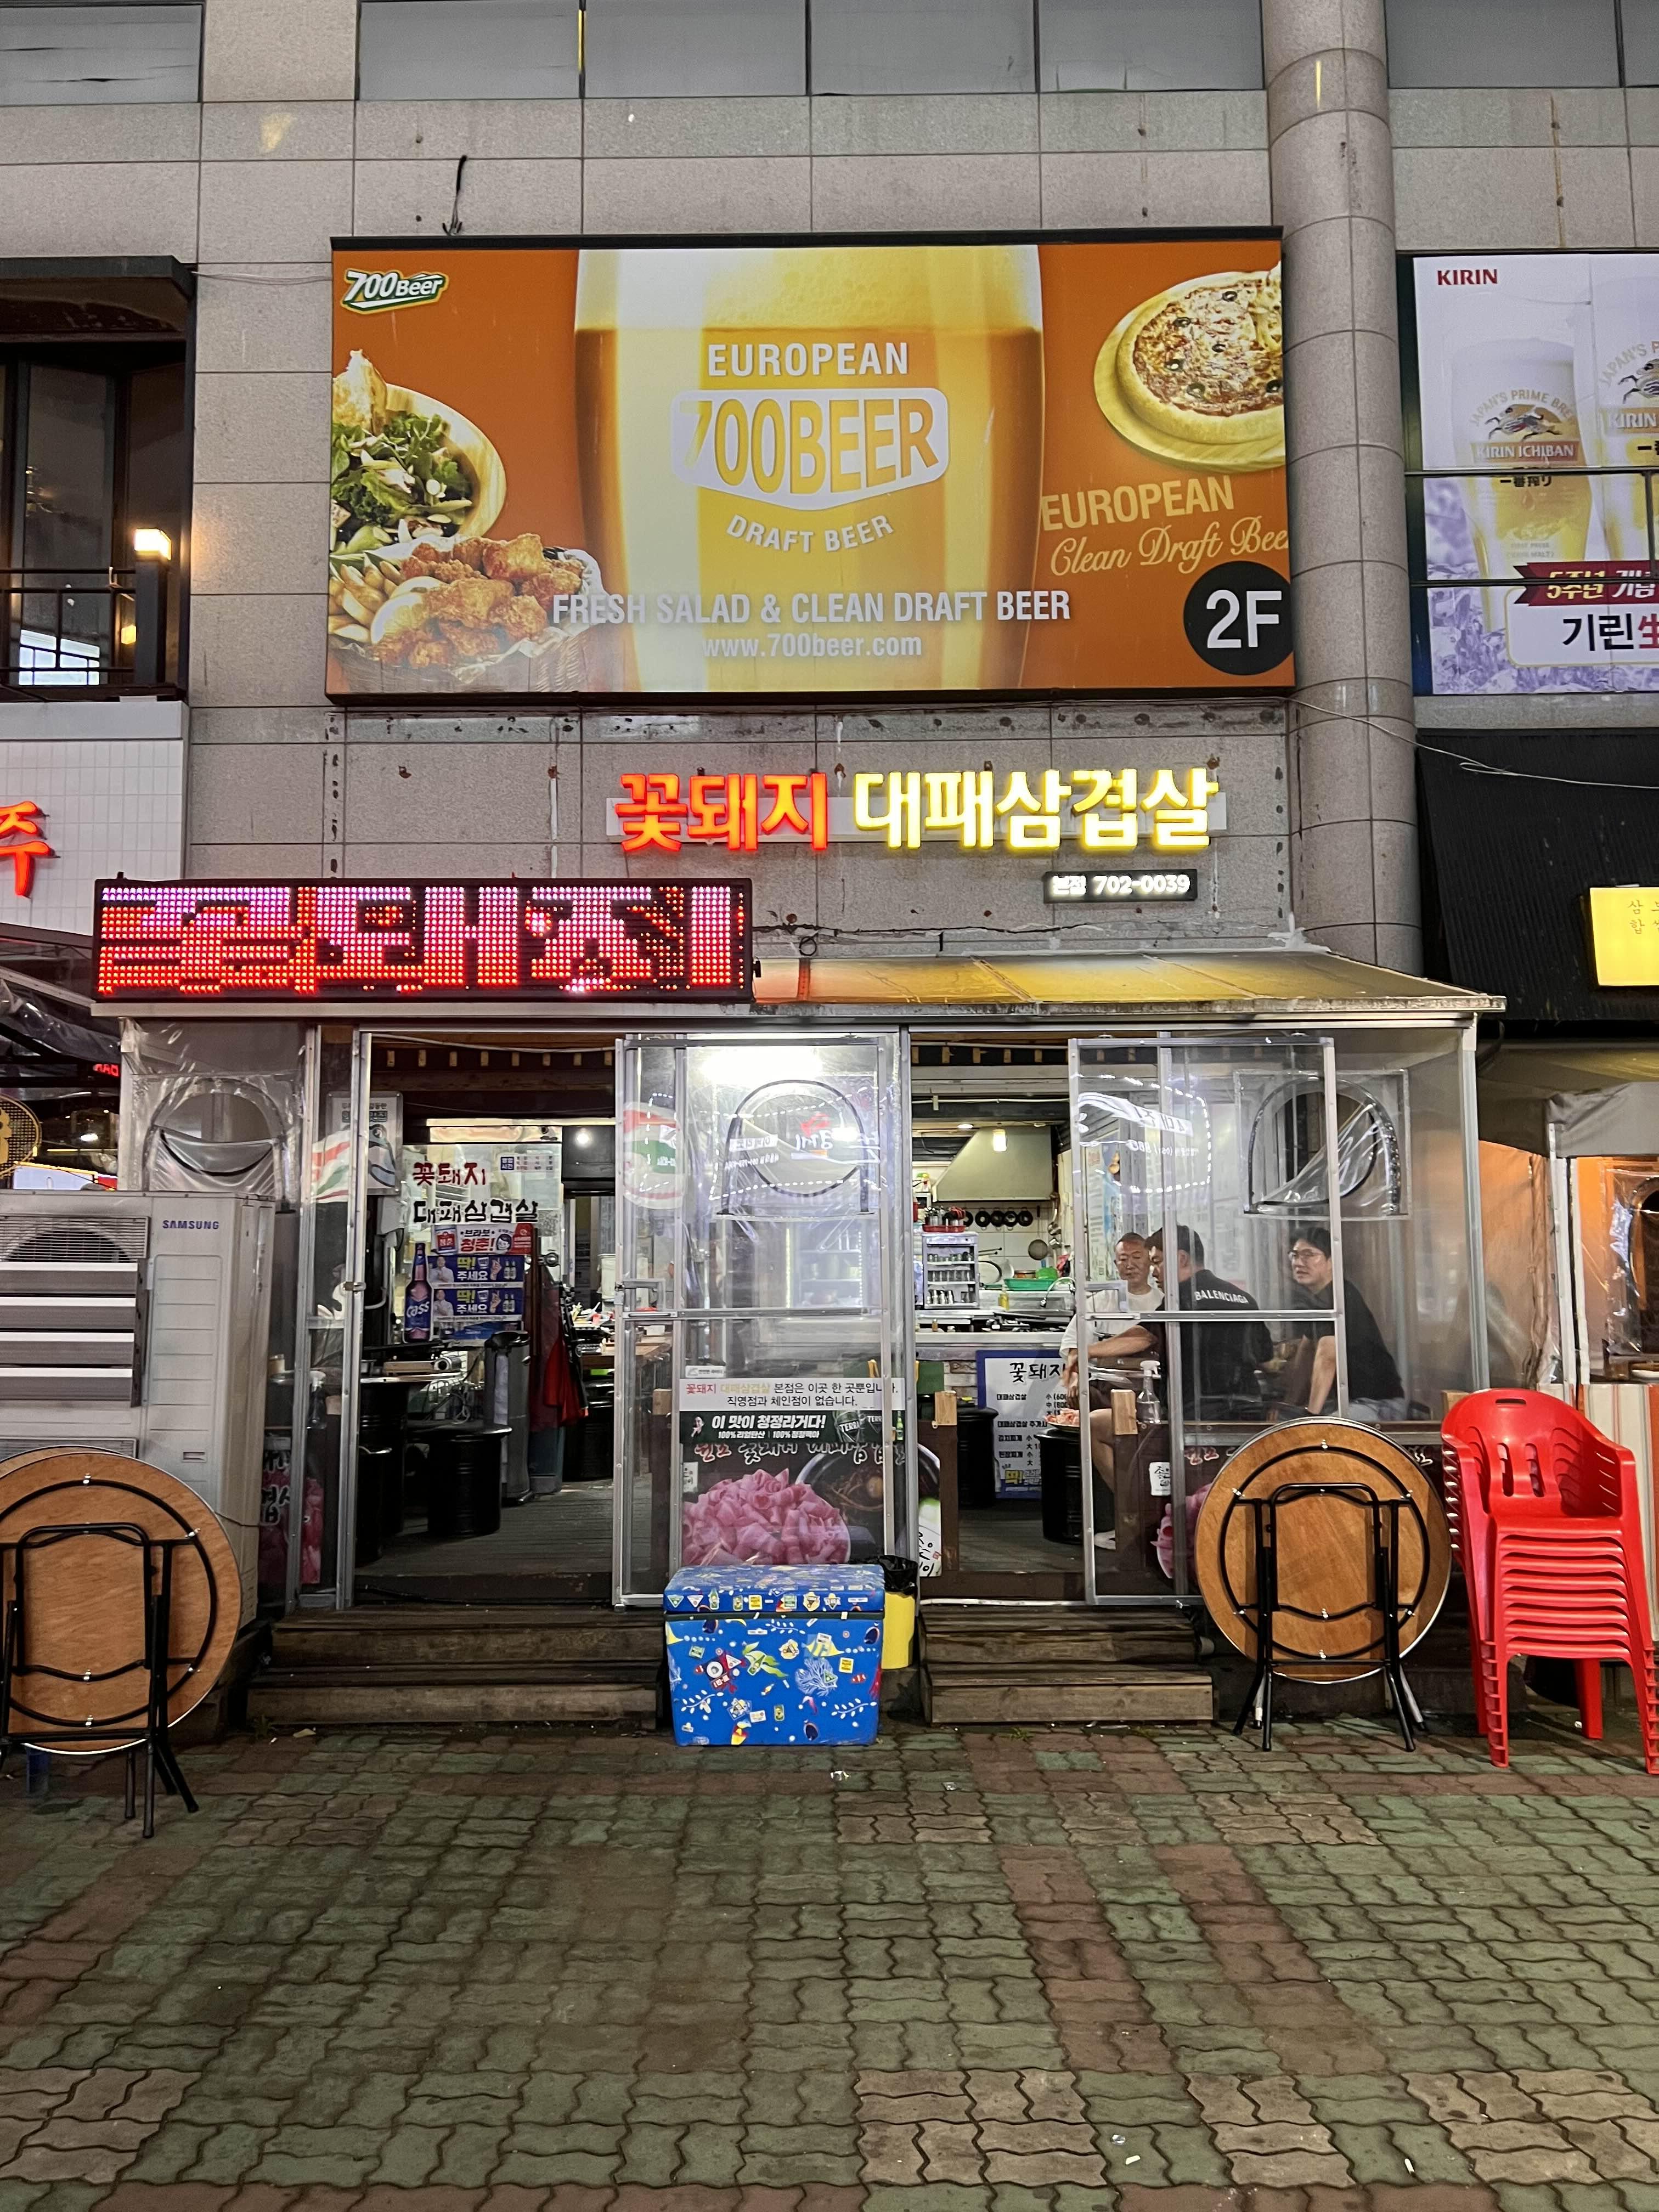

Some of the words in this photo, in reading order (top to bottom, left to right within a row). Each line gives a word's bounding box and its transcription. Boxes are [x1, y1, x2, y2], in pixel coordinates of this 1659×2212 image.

[345, 270, 443, 302] 700Beer
[1437, 268, 1498, 286] KIRIN
[708, 342, 909, 376] EUROPEAN
[1511, 389, 1550, 403] PRIME
[1610, 412, 1657, 430] KIRIN
[679, 398, 940, 495] 700BEER
[1476, 444, 1515, 459] KIRIN
[1518, 442, 1575, 459] ICHIBAN
[1042, 475, 1234, 532] EUROPEAN
[726, 514, 814, 554] DRAFT
[825, 515, 894, 552] BEER
[1050, 536, 1132, 576] Clean
[1138, 522, 1223, 574] Draft
[552, 594, 646, 625] FRESH
[657, 592, 750, 624] SALAD
[760, 594, 781, 624] &
[792, 593, 884, 623] CLEAN
[894, 592, 988, 622] DRAFT
[996, 590, 1070, 620] BEER
[1206, 589, 1283, 649] 2F
[702, 633, 922, 658] www.700beer.com
[615, 773, 828, 852] 꽃돼지
[854, 768, 1220, 850] 대패삼겹살
[1093, 874, 1191, 895] 702-0039
[413, 1162, 487, 1186] 꽃돼지
[413, 1199, 539, 1224] 대패삼겹살
[162, 1220, 219, 1230] SAMSUNG
[456, 1271, 488, 1280] 주세요
[1194, 1289, 1250, 1304] BALENCIAGA
[456, 1304, 488, 1314] 주세요
[686, 1383, 716, 1394] 꽃돼지
[720, 1383, 771, 1394] 대패삼겹살
[774, 1383, 804, 1393] 본점은
[808, 1383, 828, 1393] 이곳
[832, 1382, 842, 1393] 한
[727, 1396, 768, 1407] 직영점과
[770, 1396, 811, 1406] 체인점이
[815, 1395, 858, 1406] 없습니다.
[712, 1415, 726, 1429] 이
[728, 1415, 755, 1429] 맛이
[757, 1414, 827, 1429] 청정라거다!
[718, 1431, 736, 1439] 100%
[772, 1430, 791, 1438] 100%
